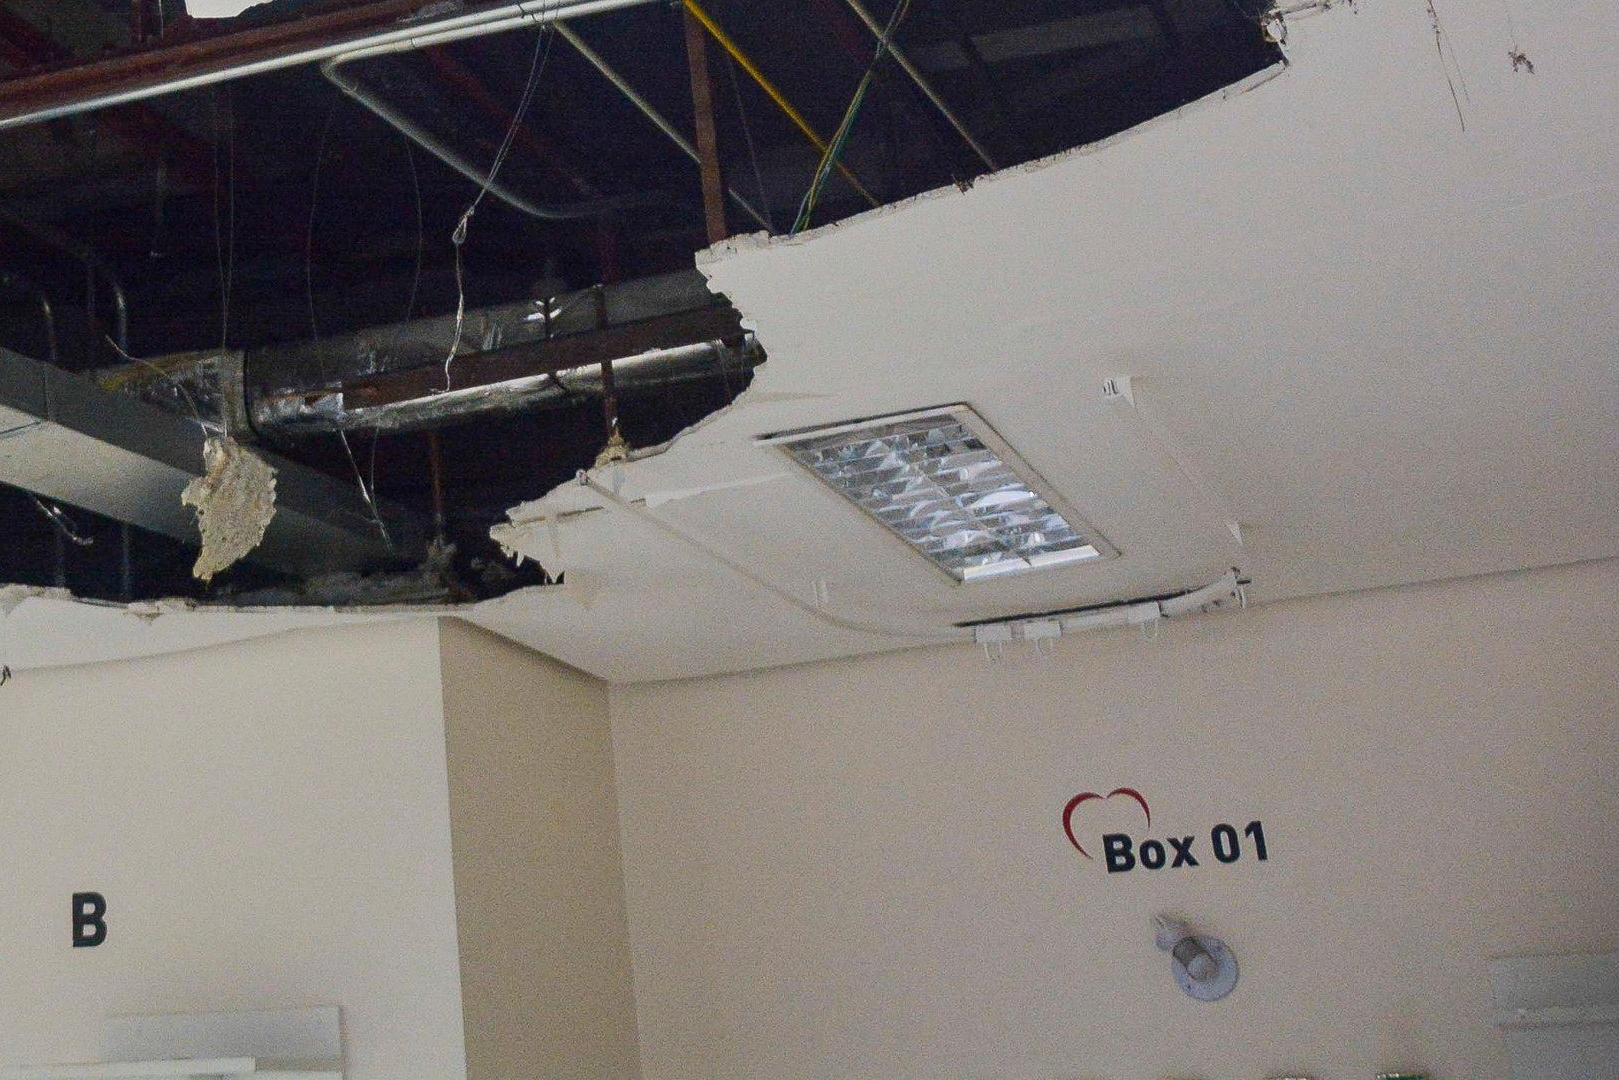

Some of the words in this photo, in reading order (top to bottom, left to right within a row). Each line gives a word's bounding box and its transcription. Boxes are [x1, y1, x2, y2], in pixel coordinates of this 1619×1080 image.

[1102, 831, 1200, 875] Box
[1210, 819, 1269, 865] 01
[70, 891, 109, 949] B
